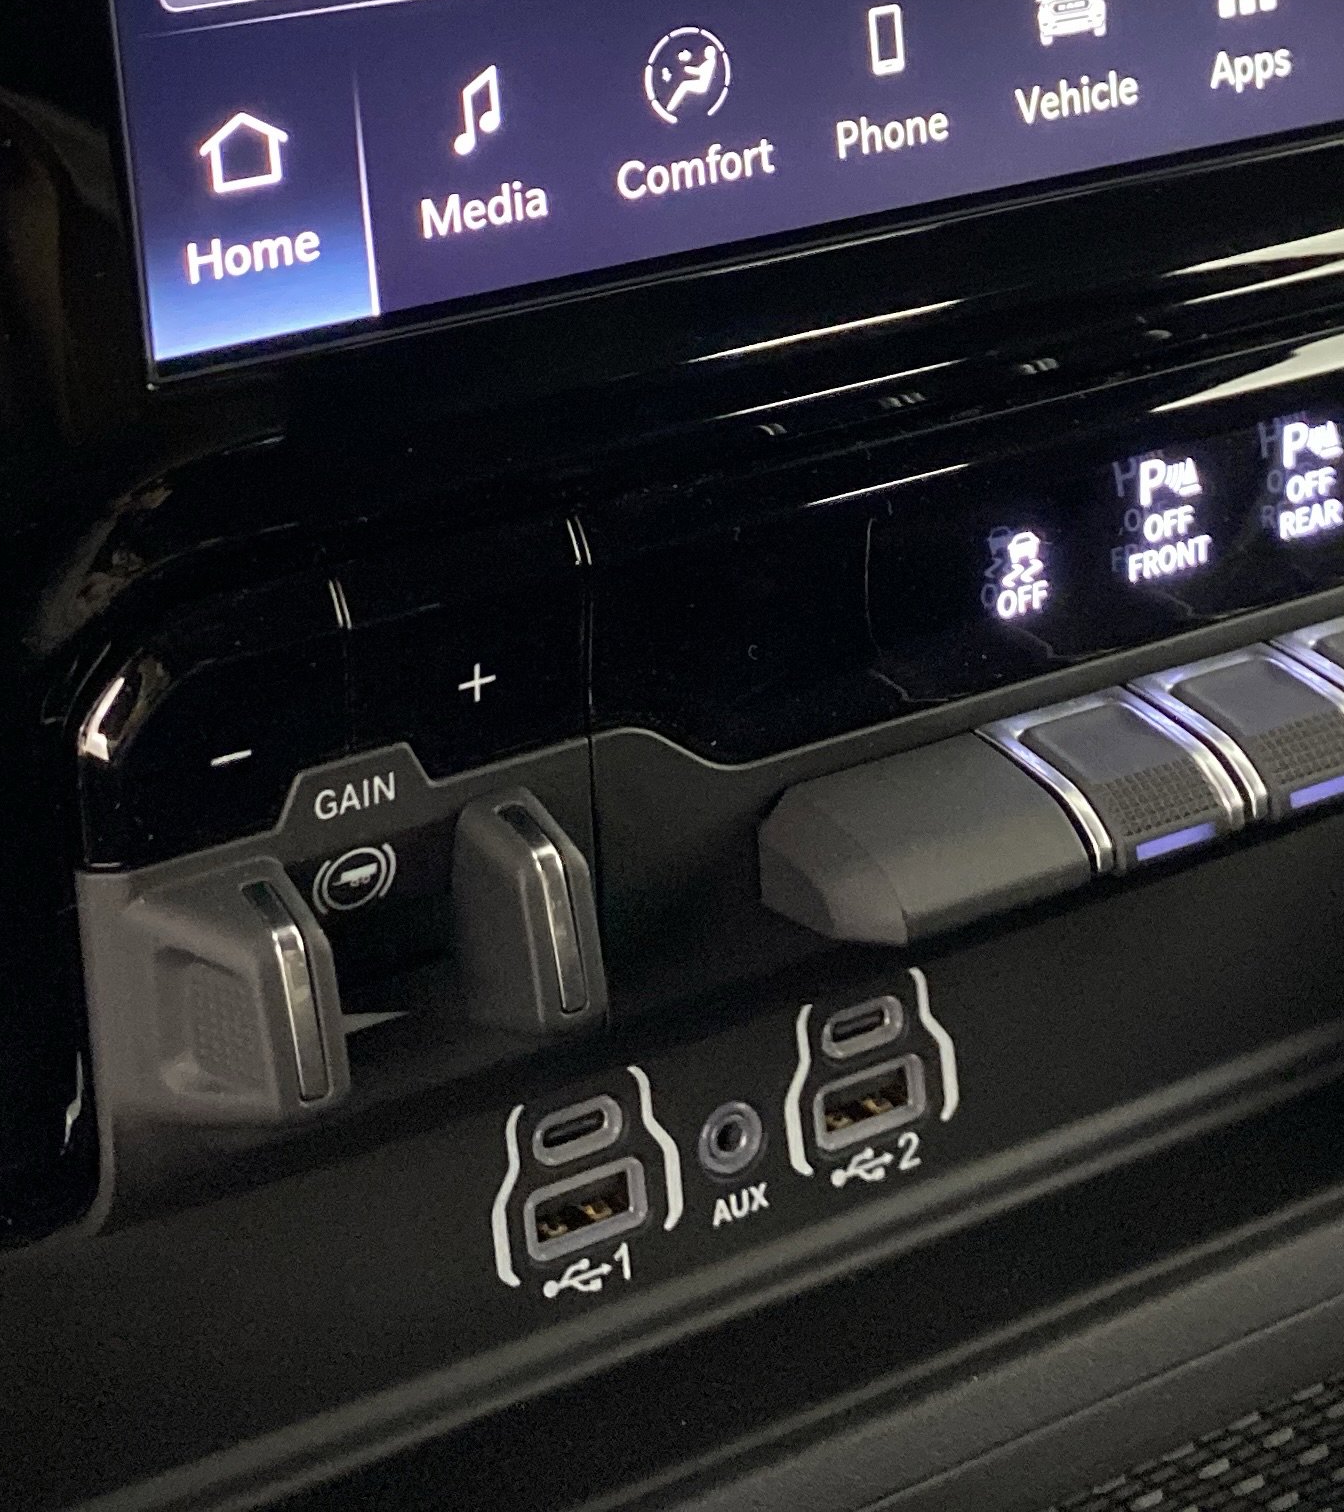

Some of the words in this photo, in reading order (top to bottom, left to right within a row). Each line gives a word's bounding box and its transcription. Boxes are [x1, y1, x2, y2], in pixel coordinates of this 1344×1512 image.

[1209, 44, 1293, 94] Apps
[1014, 69, 1140, 125] Vehicle
[835, 109, 951, 161] Phone
[615, 138, 777, 201] Comfort
[419, 180, 550, 240] Media
[184, 229, 322, 285] Home
[1285, 466, 1338, 505] OFF
[1142, 504, 1196, 544] OFF
[1278, 497, 1344, 542] REAR
[1127, 534, 1213, 584] FRONT
[996, 579, 1050, 620] OFF
[313, 771, 397, 822] GAIN
[897, 1132, 921, 1172] 2
[712, 1181, 771, 1227] AUX
[614, 1241, 632, 1281] 1
